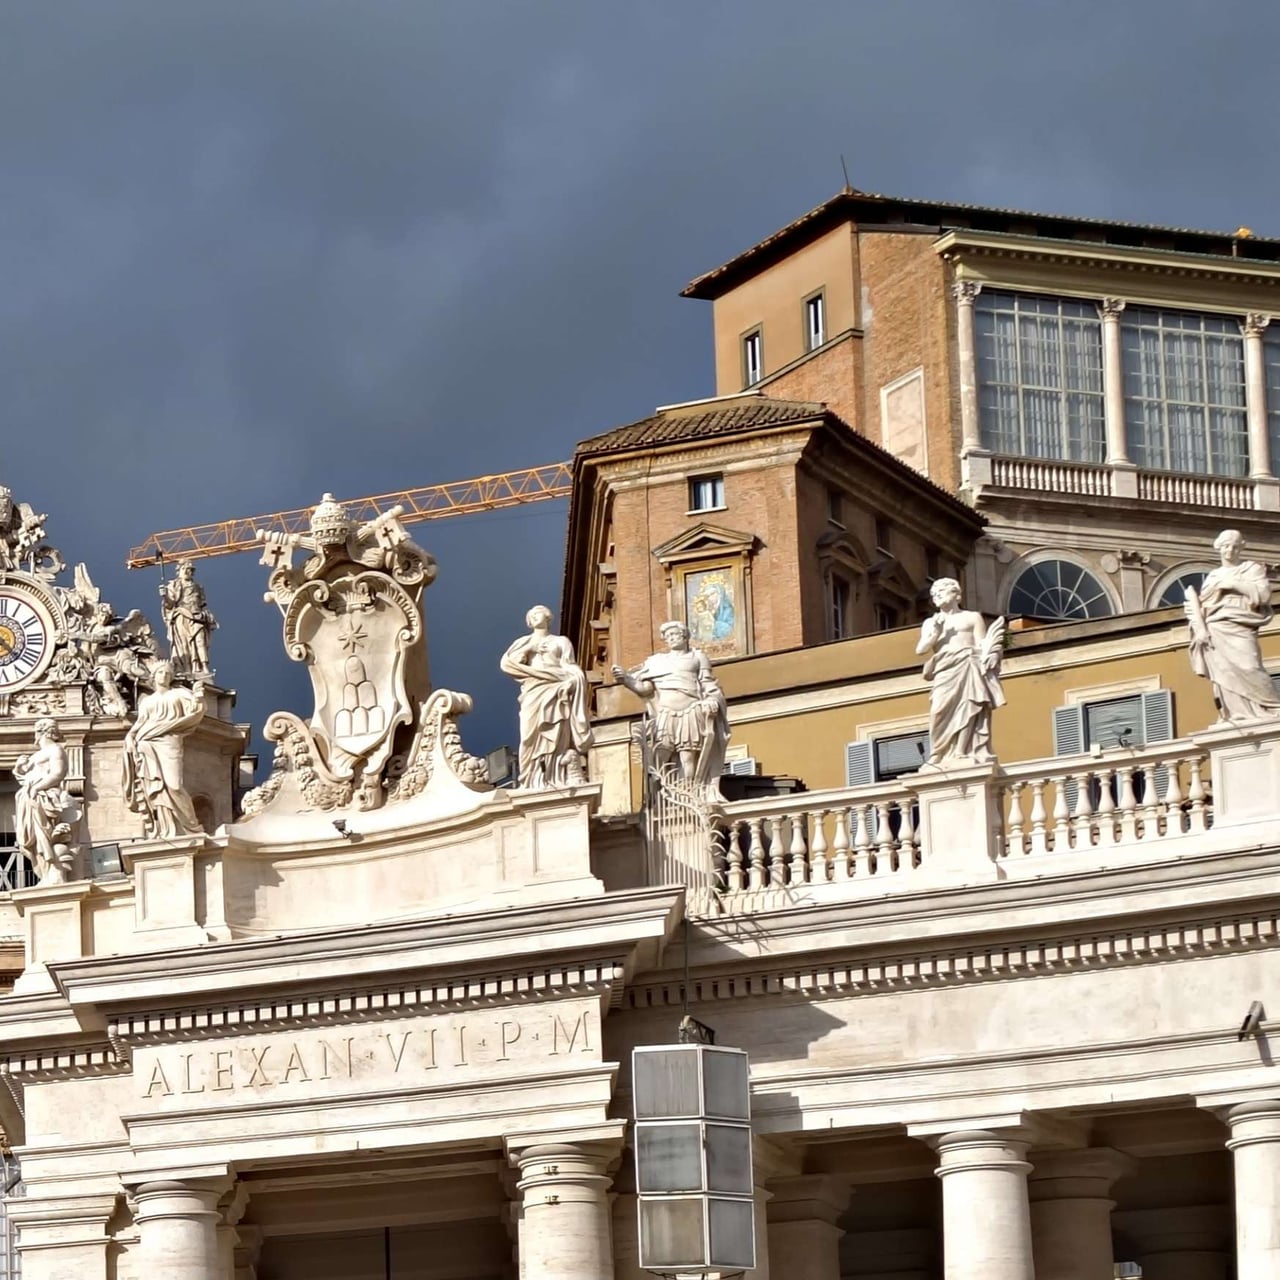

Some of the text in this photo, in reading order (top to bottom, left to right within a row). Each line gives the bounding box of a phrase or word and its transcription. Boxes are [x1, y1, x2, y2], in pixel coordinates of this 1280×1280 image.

[141, 1010, 596, 1099] ALEXAN VII P M
